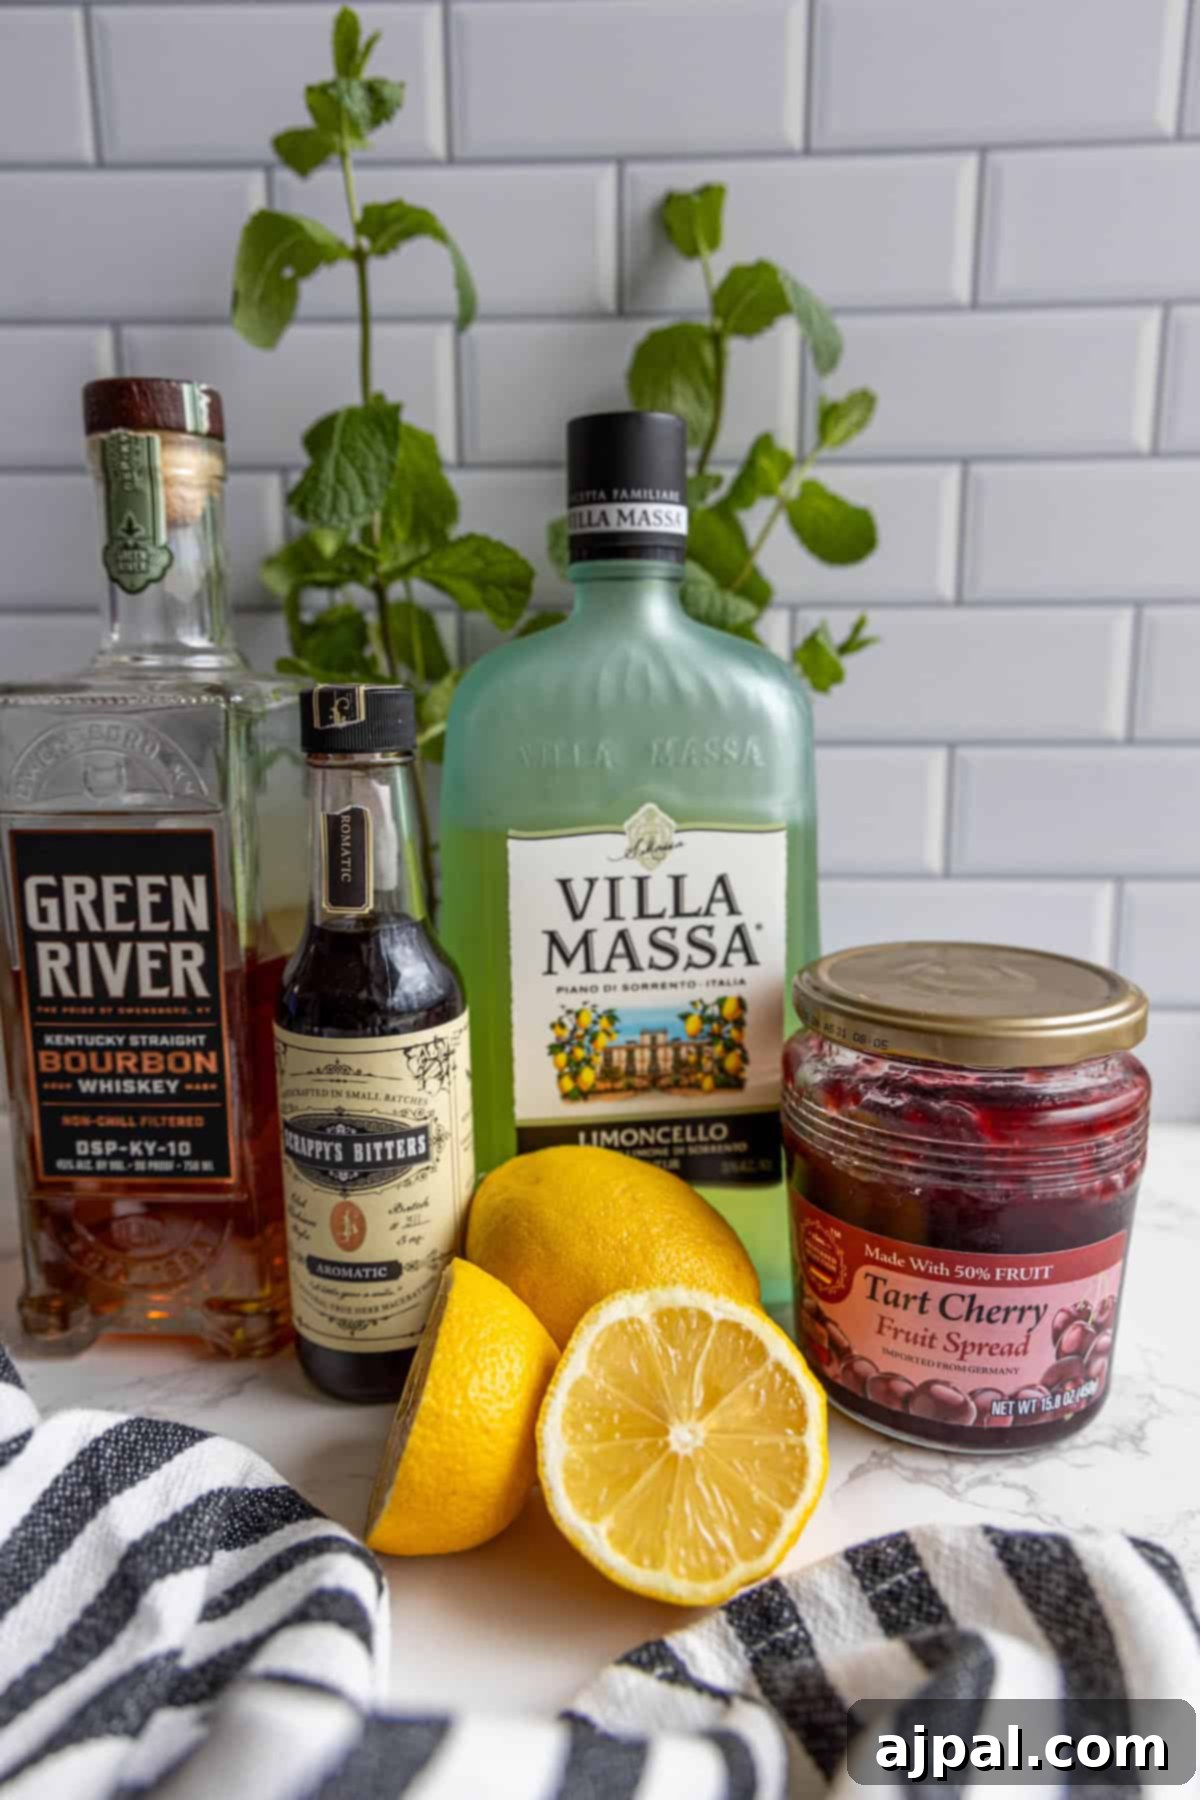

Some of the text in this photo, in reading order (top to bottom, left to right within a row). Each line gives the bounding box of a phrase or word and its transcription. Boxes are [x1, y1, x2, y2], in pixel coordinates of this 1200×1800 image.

[650, 735, 766, 768] MASSA
[340, 813, 352, 884] ROMATIC
[24, 875, 210, 931] GREEN
[555, 873, 742, 922] VILLA
[543, 923, 761, 976] MASSA
[36, 942, 210, 998] RIVER
[556, 977, 747, 994] PIANO DI SORRENTO ITALIA
[44, 1034, 207, 1047] KENTUCKY STRAIGHT
[38, 1050, 218, 1074] BOURBON
[77, 1079, 180, 1094] WHISKEY
[331, 1091, 344, 1099] IN
[345, 1092, 381, 1102] SMALL
[384, 1094, 429, 1106] BATCHES
[61, 1115, 205, 1128] NON-CHILL FILTERED
[577, 1123, 728, 1147] LIMONCELLO
[75, 1140, 191, 1156] DSP-KY-10
[353, 1134, 427, 1162] BITTERS
[315, 1264, 388, 1279] AROMATIC
[864, 1244, 1054, 1281] Made With 50% FRUIT
[864, 1272, 1048, 1334] Tart Cherry
[876, 1314, 1031, 1362] Fruit Spread
[882, 1347, 1020, 1376] IMPORTED FROM GERMANY
[991, 1399, 1015, 1416] NET
[1017, 1398, 1037, 1414] WT
[1041, 1394, 1061, 1411] 15.8
